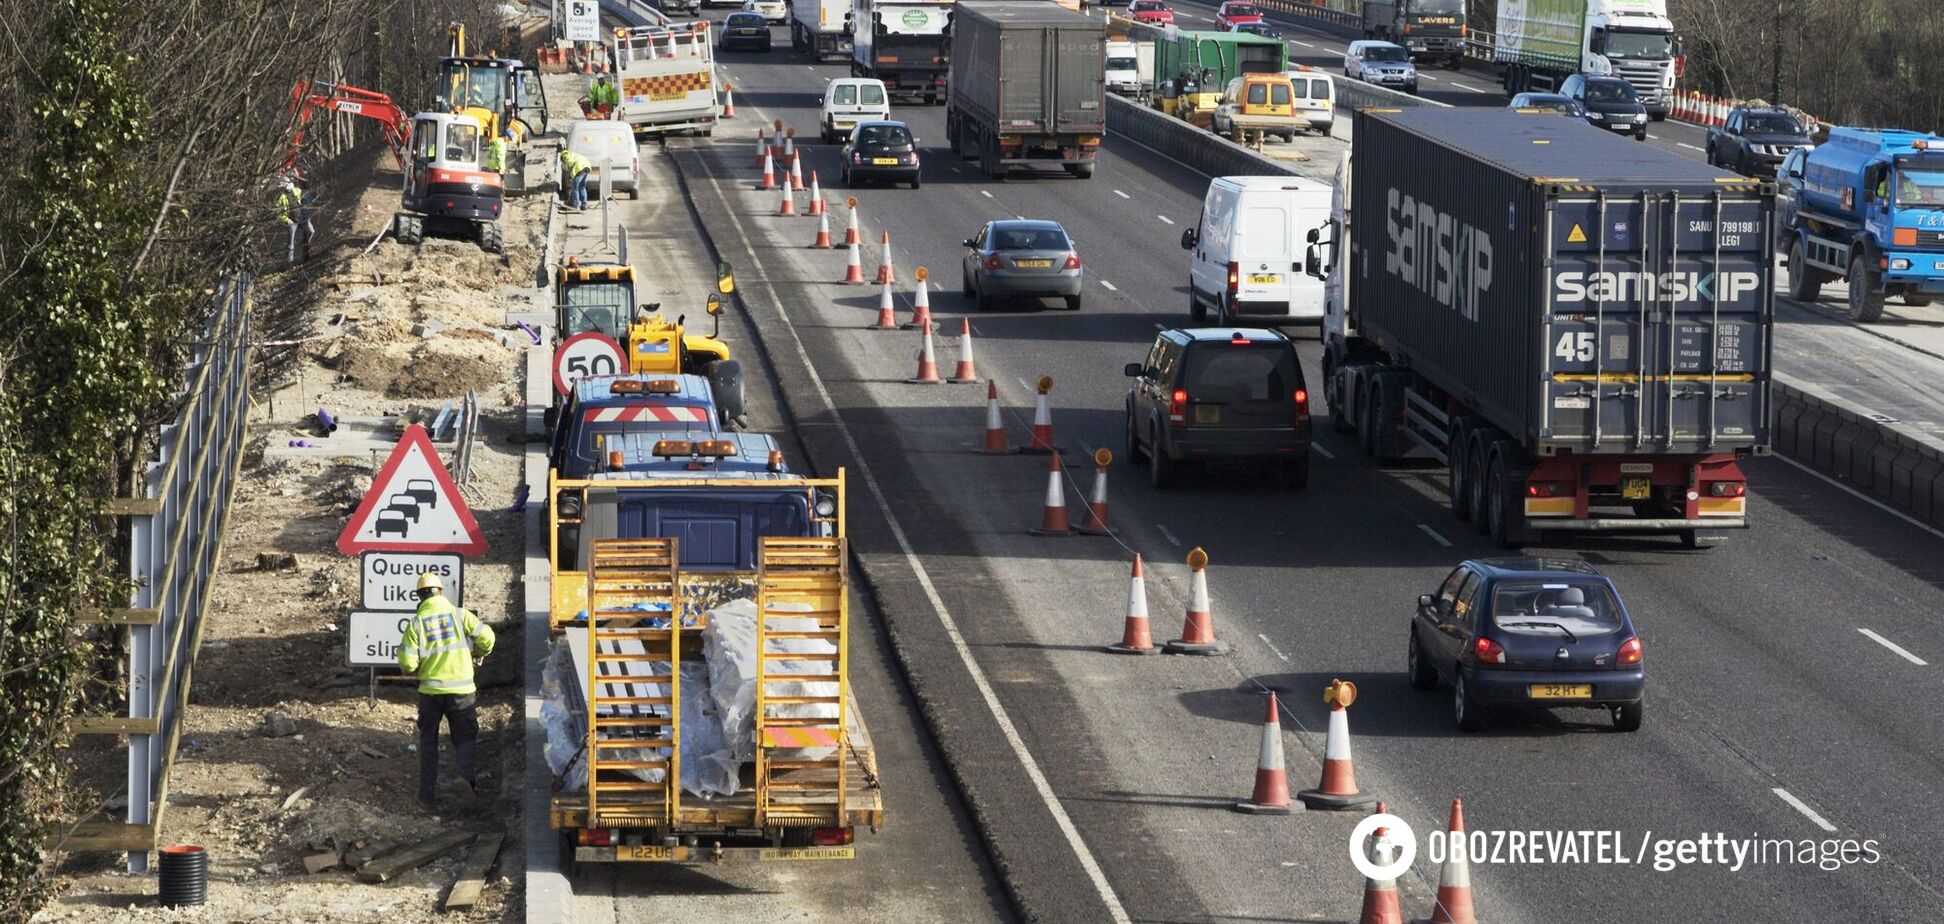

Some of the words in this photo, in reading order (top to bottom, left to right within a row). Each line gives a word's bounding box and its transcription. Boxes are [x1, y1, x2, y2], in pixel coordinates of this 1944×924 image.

[1689, 221, 1713, 233] SANU
[1721, 221, 1753, 233] 799198
[1721, 235, 1741, 247] LEG1
[1555, 331, 1595, 362] 45
[567, 354, 615, 382] 50
[372, 558, 451, 576] Queues
[804, 848, 848, 858] MAINTENANCE
